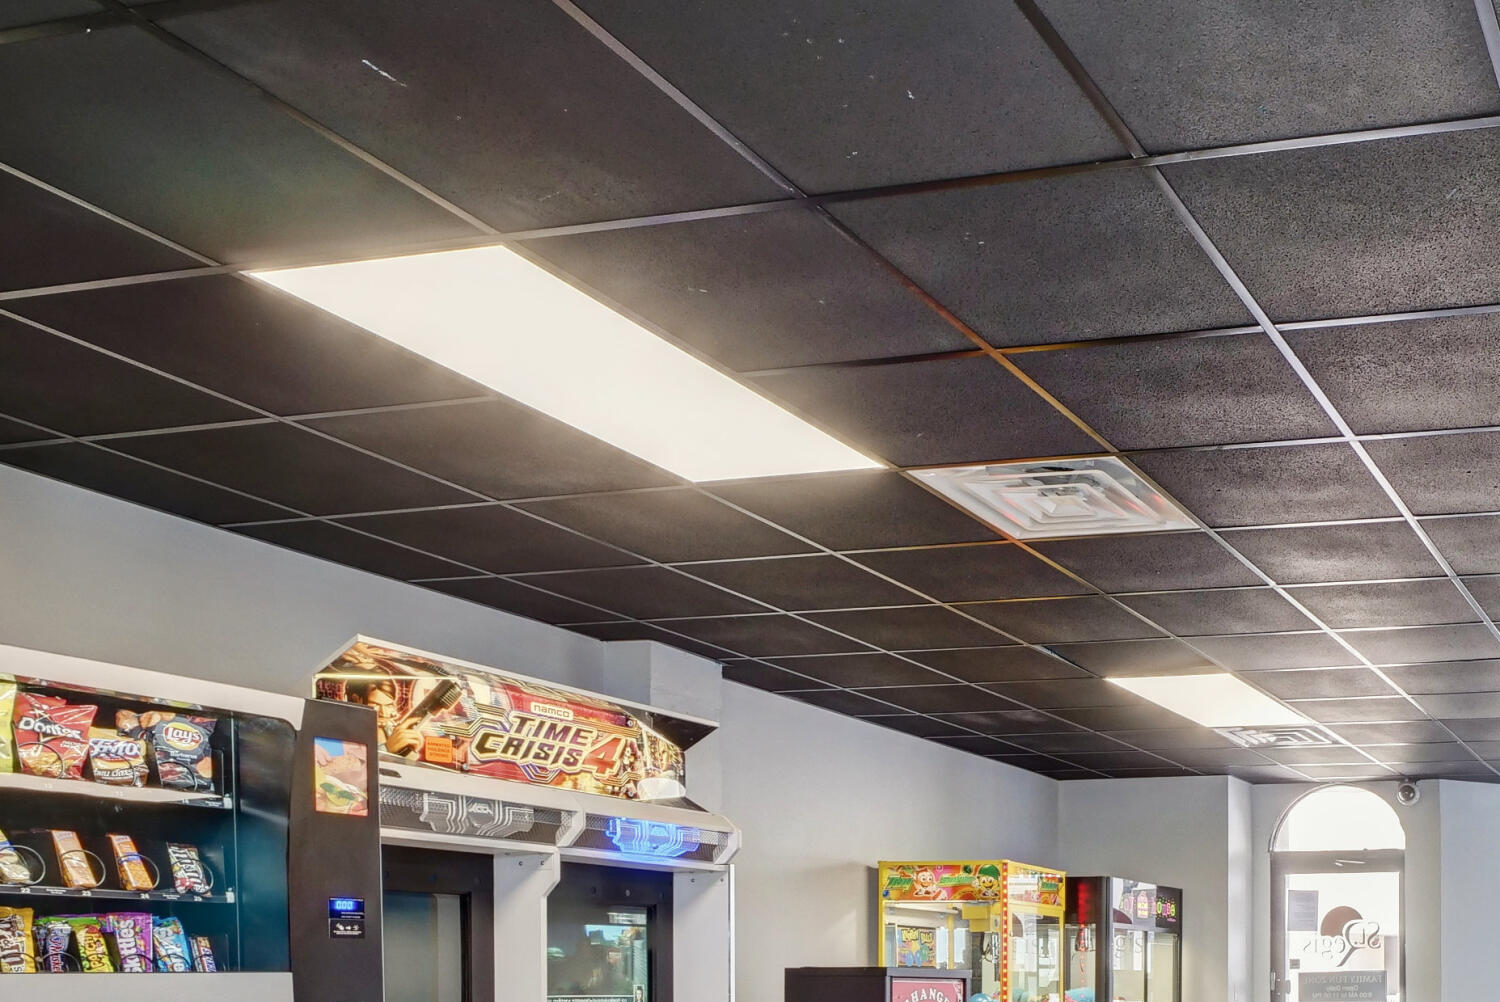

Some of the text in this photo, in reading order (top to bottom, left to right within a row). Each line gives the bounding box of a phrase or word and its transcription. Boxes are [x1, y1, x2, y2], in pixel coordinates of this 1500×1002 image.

[534, 704, 571, 718] namco
[19, 717, 81, 739] Doritos
[512, 715, 592, 748] TIME
[475, 732, 584, 768] CRISIS
[583, 737, 626, 776] 4
